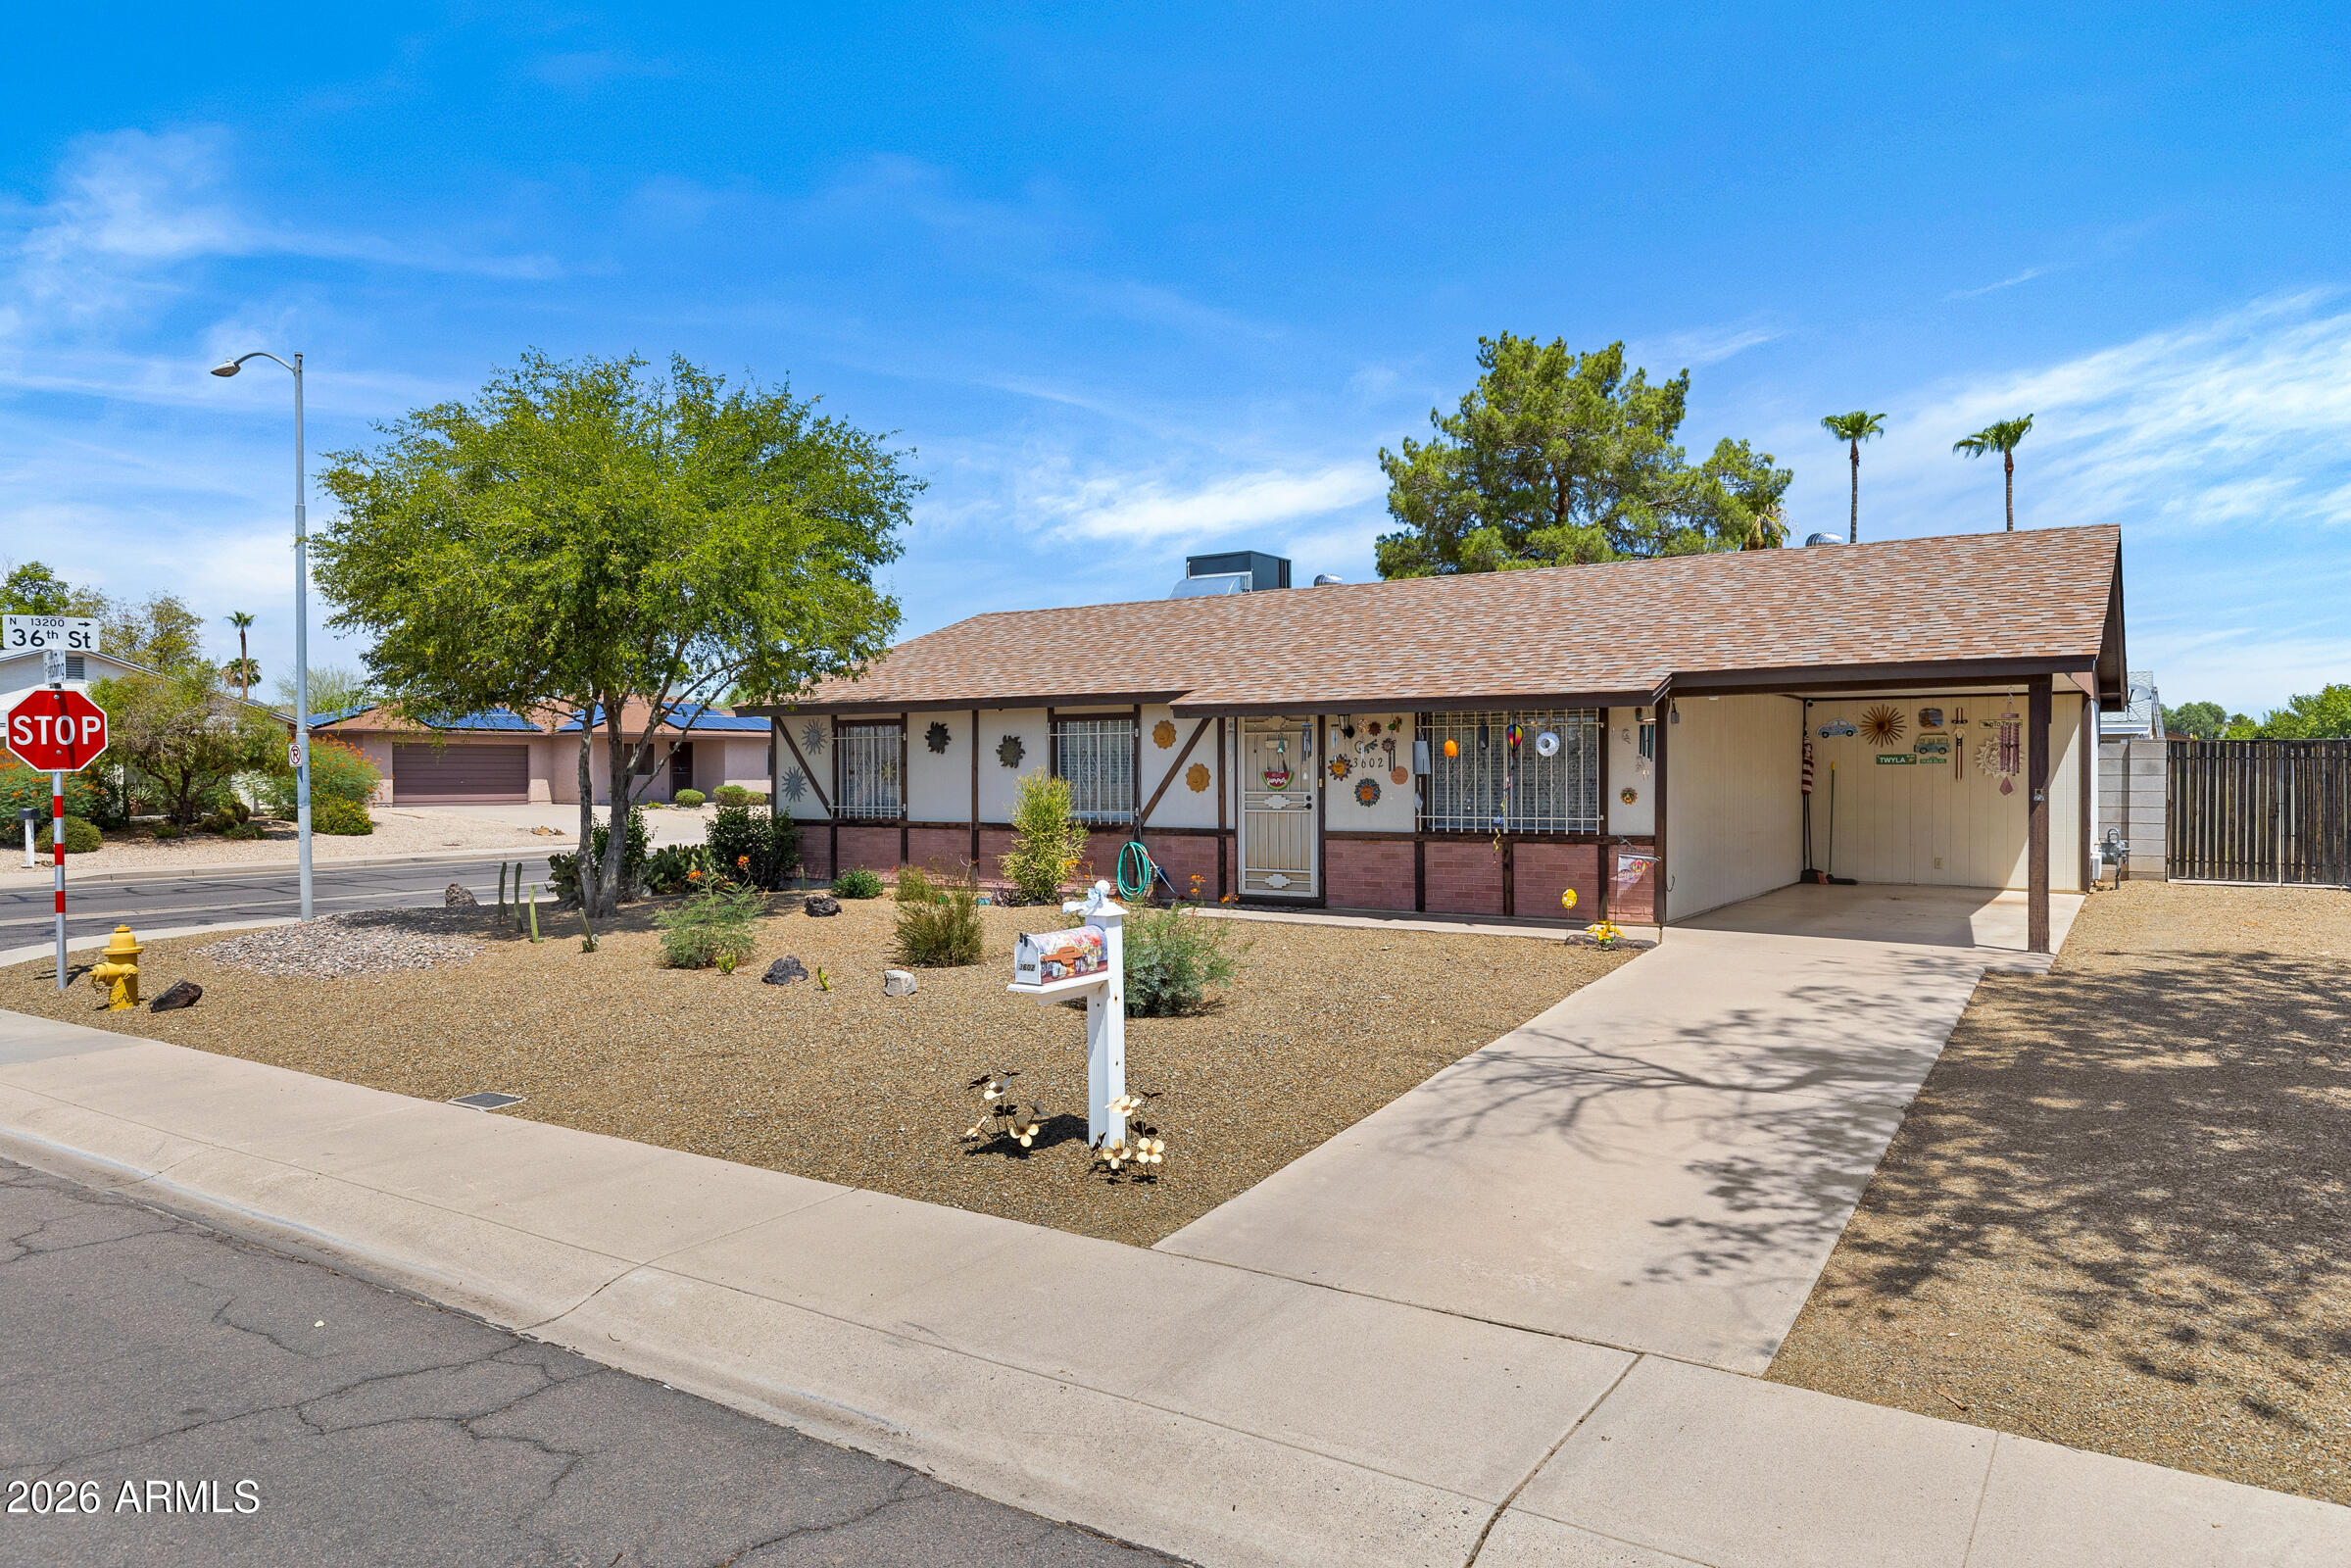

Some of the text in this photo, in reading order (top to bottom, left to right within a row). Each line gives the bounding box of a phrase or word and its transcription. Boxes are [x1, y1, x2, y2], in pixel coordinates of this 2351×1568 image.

[30, 618, 65, 627] 13200
[12, 628, 91, 649] 36th St
[13, 715, 101, 746] STOP
[1352, 757, 1383, 768] 3602
